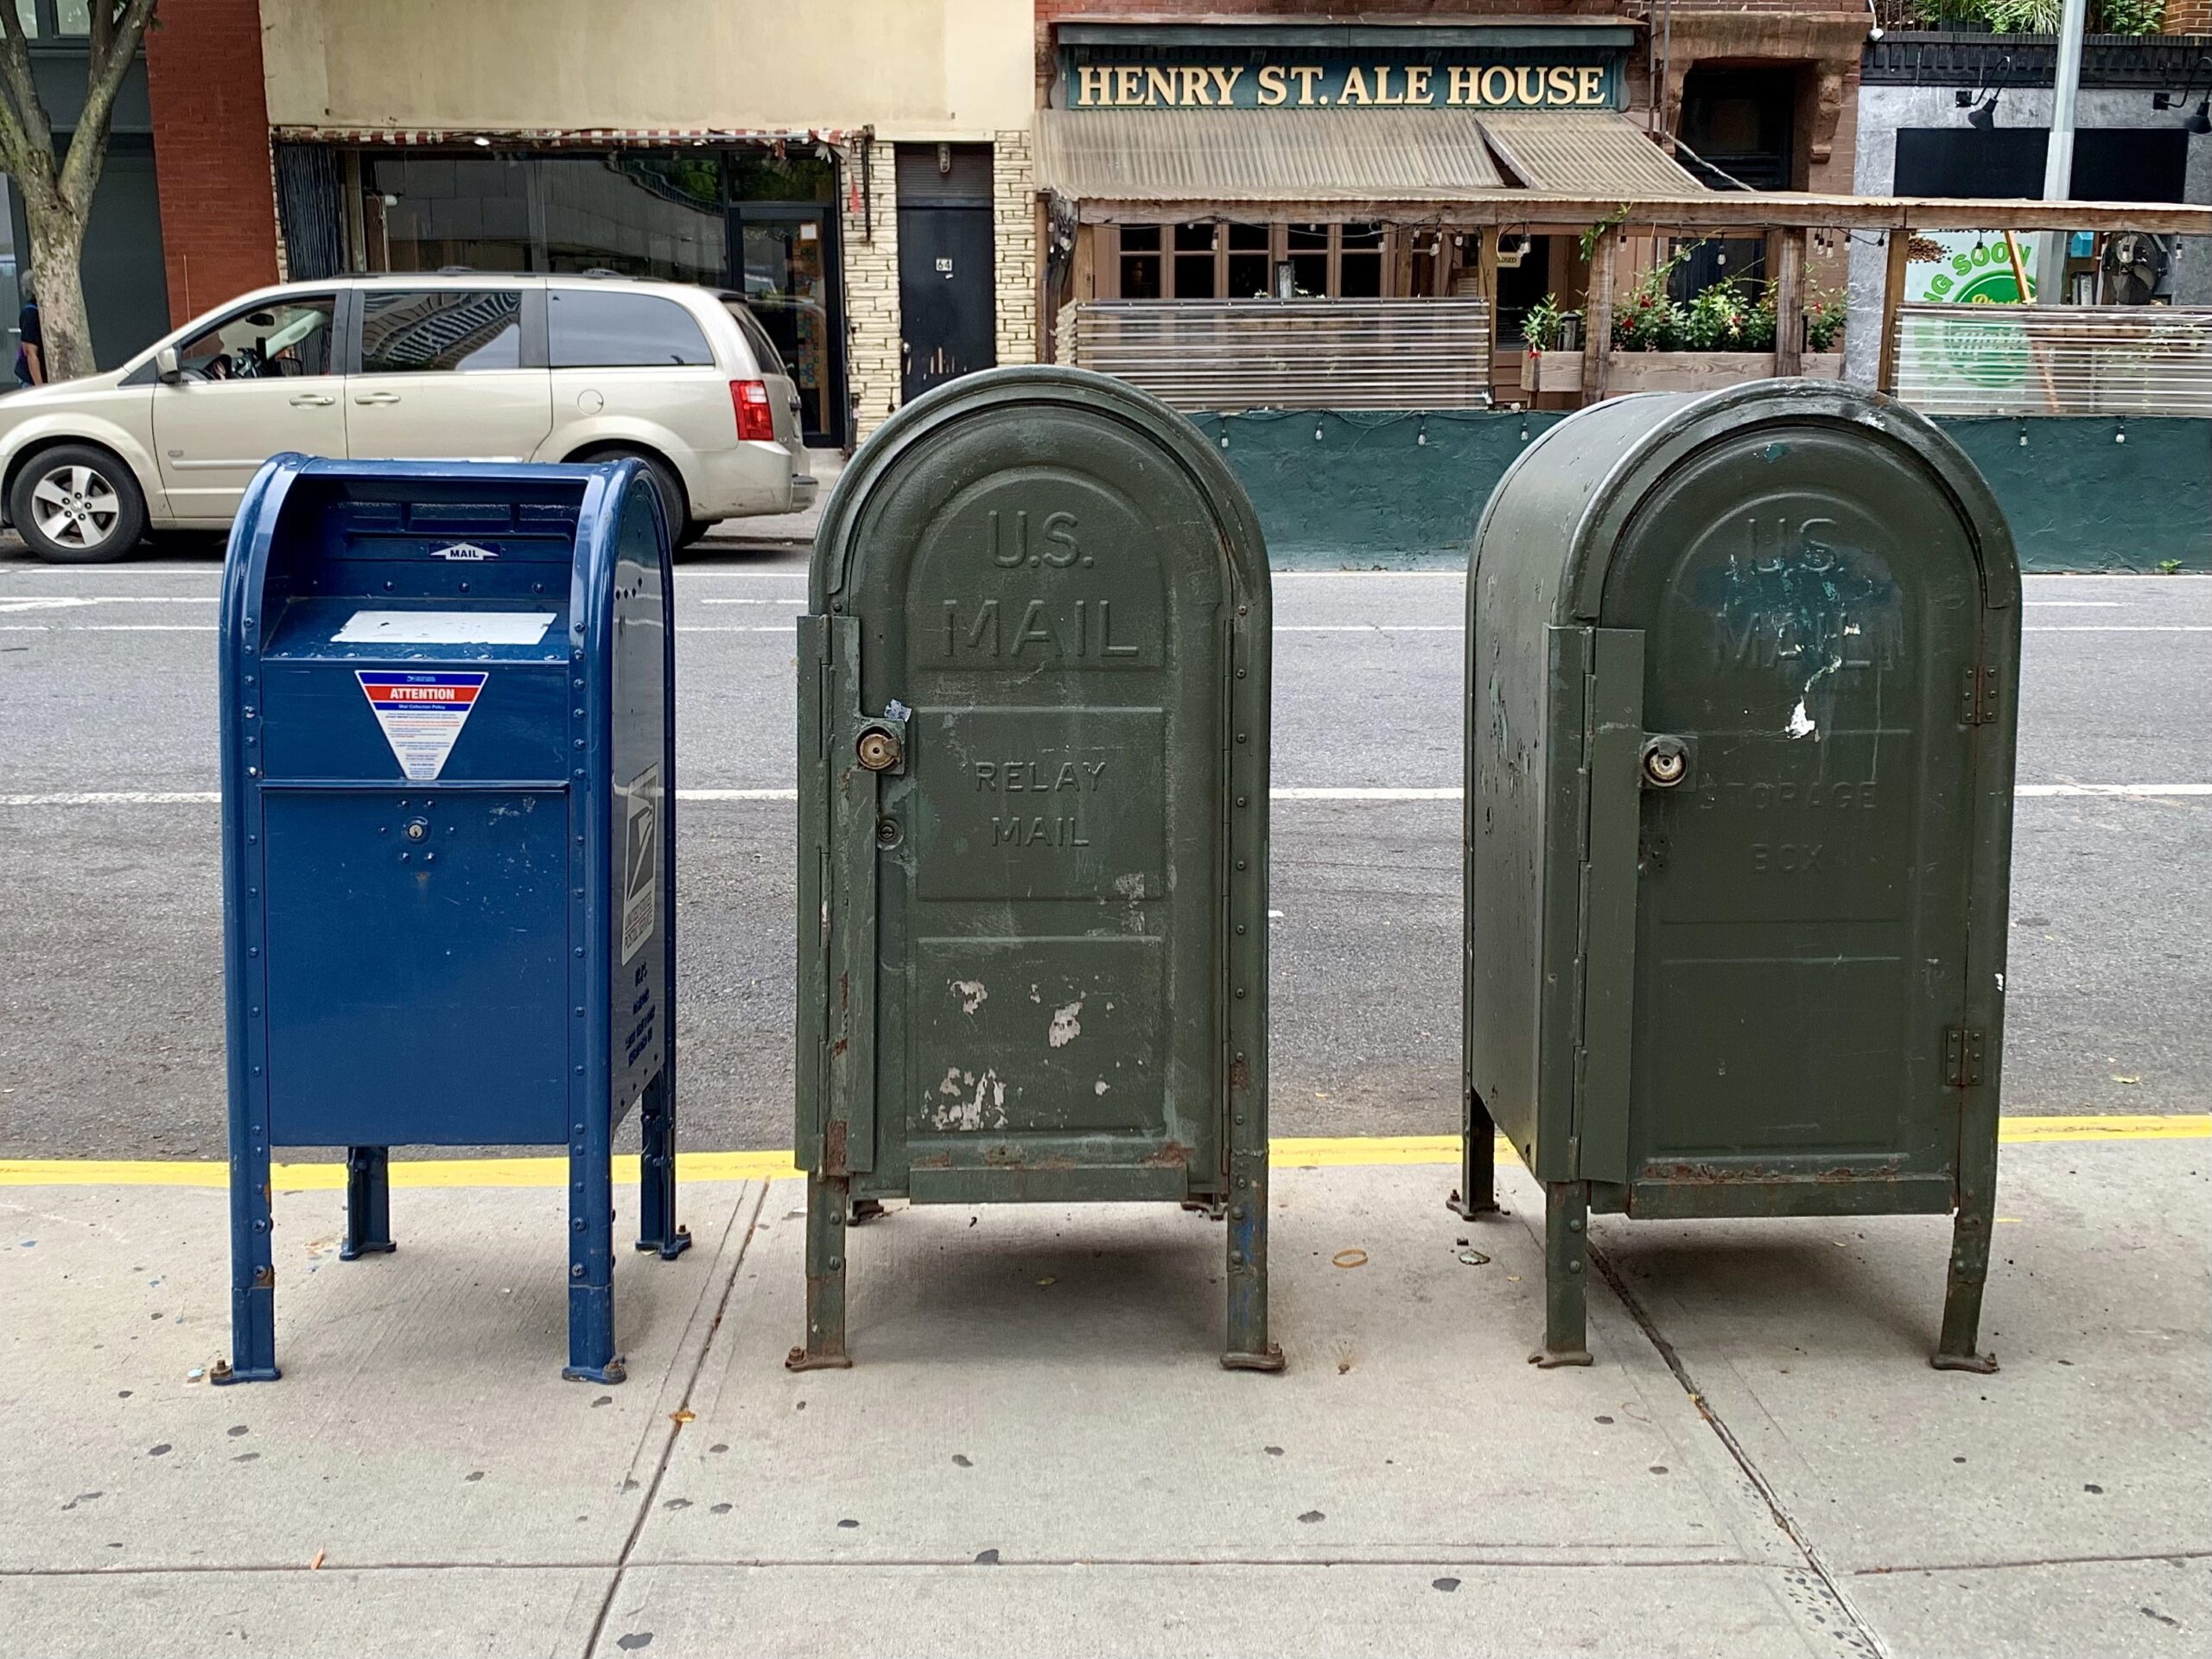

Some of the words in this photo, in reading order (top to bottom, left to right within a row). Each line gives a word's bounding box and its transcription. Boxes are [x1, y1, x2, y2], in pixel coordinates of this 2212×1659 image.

[1077, 66, 1244, 105] HENRY
[1257, 66, 1329, 105] ST.
[1337, 66, 1434, 105] ALE
[1446, 66, 1605, 105] HOUSE
[938, 260, 950, 270] 64
[450, 550, 480, 558] MAIL
[988, 510, 1095, 569] U.S.
[943, 600, 1140, 658] MAIL
[1715, 612, 1872, 671] MAIL
[390, 688, 455, 701] ATTENTION
[976, 761, 1106, 792] RELAY
[992, 817, 1090, 847] MAIL
[1751, 842, 1824, 870] BOX
